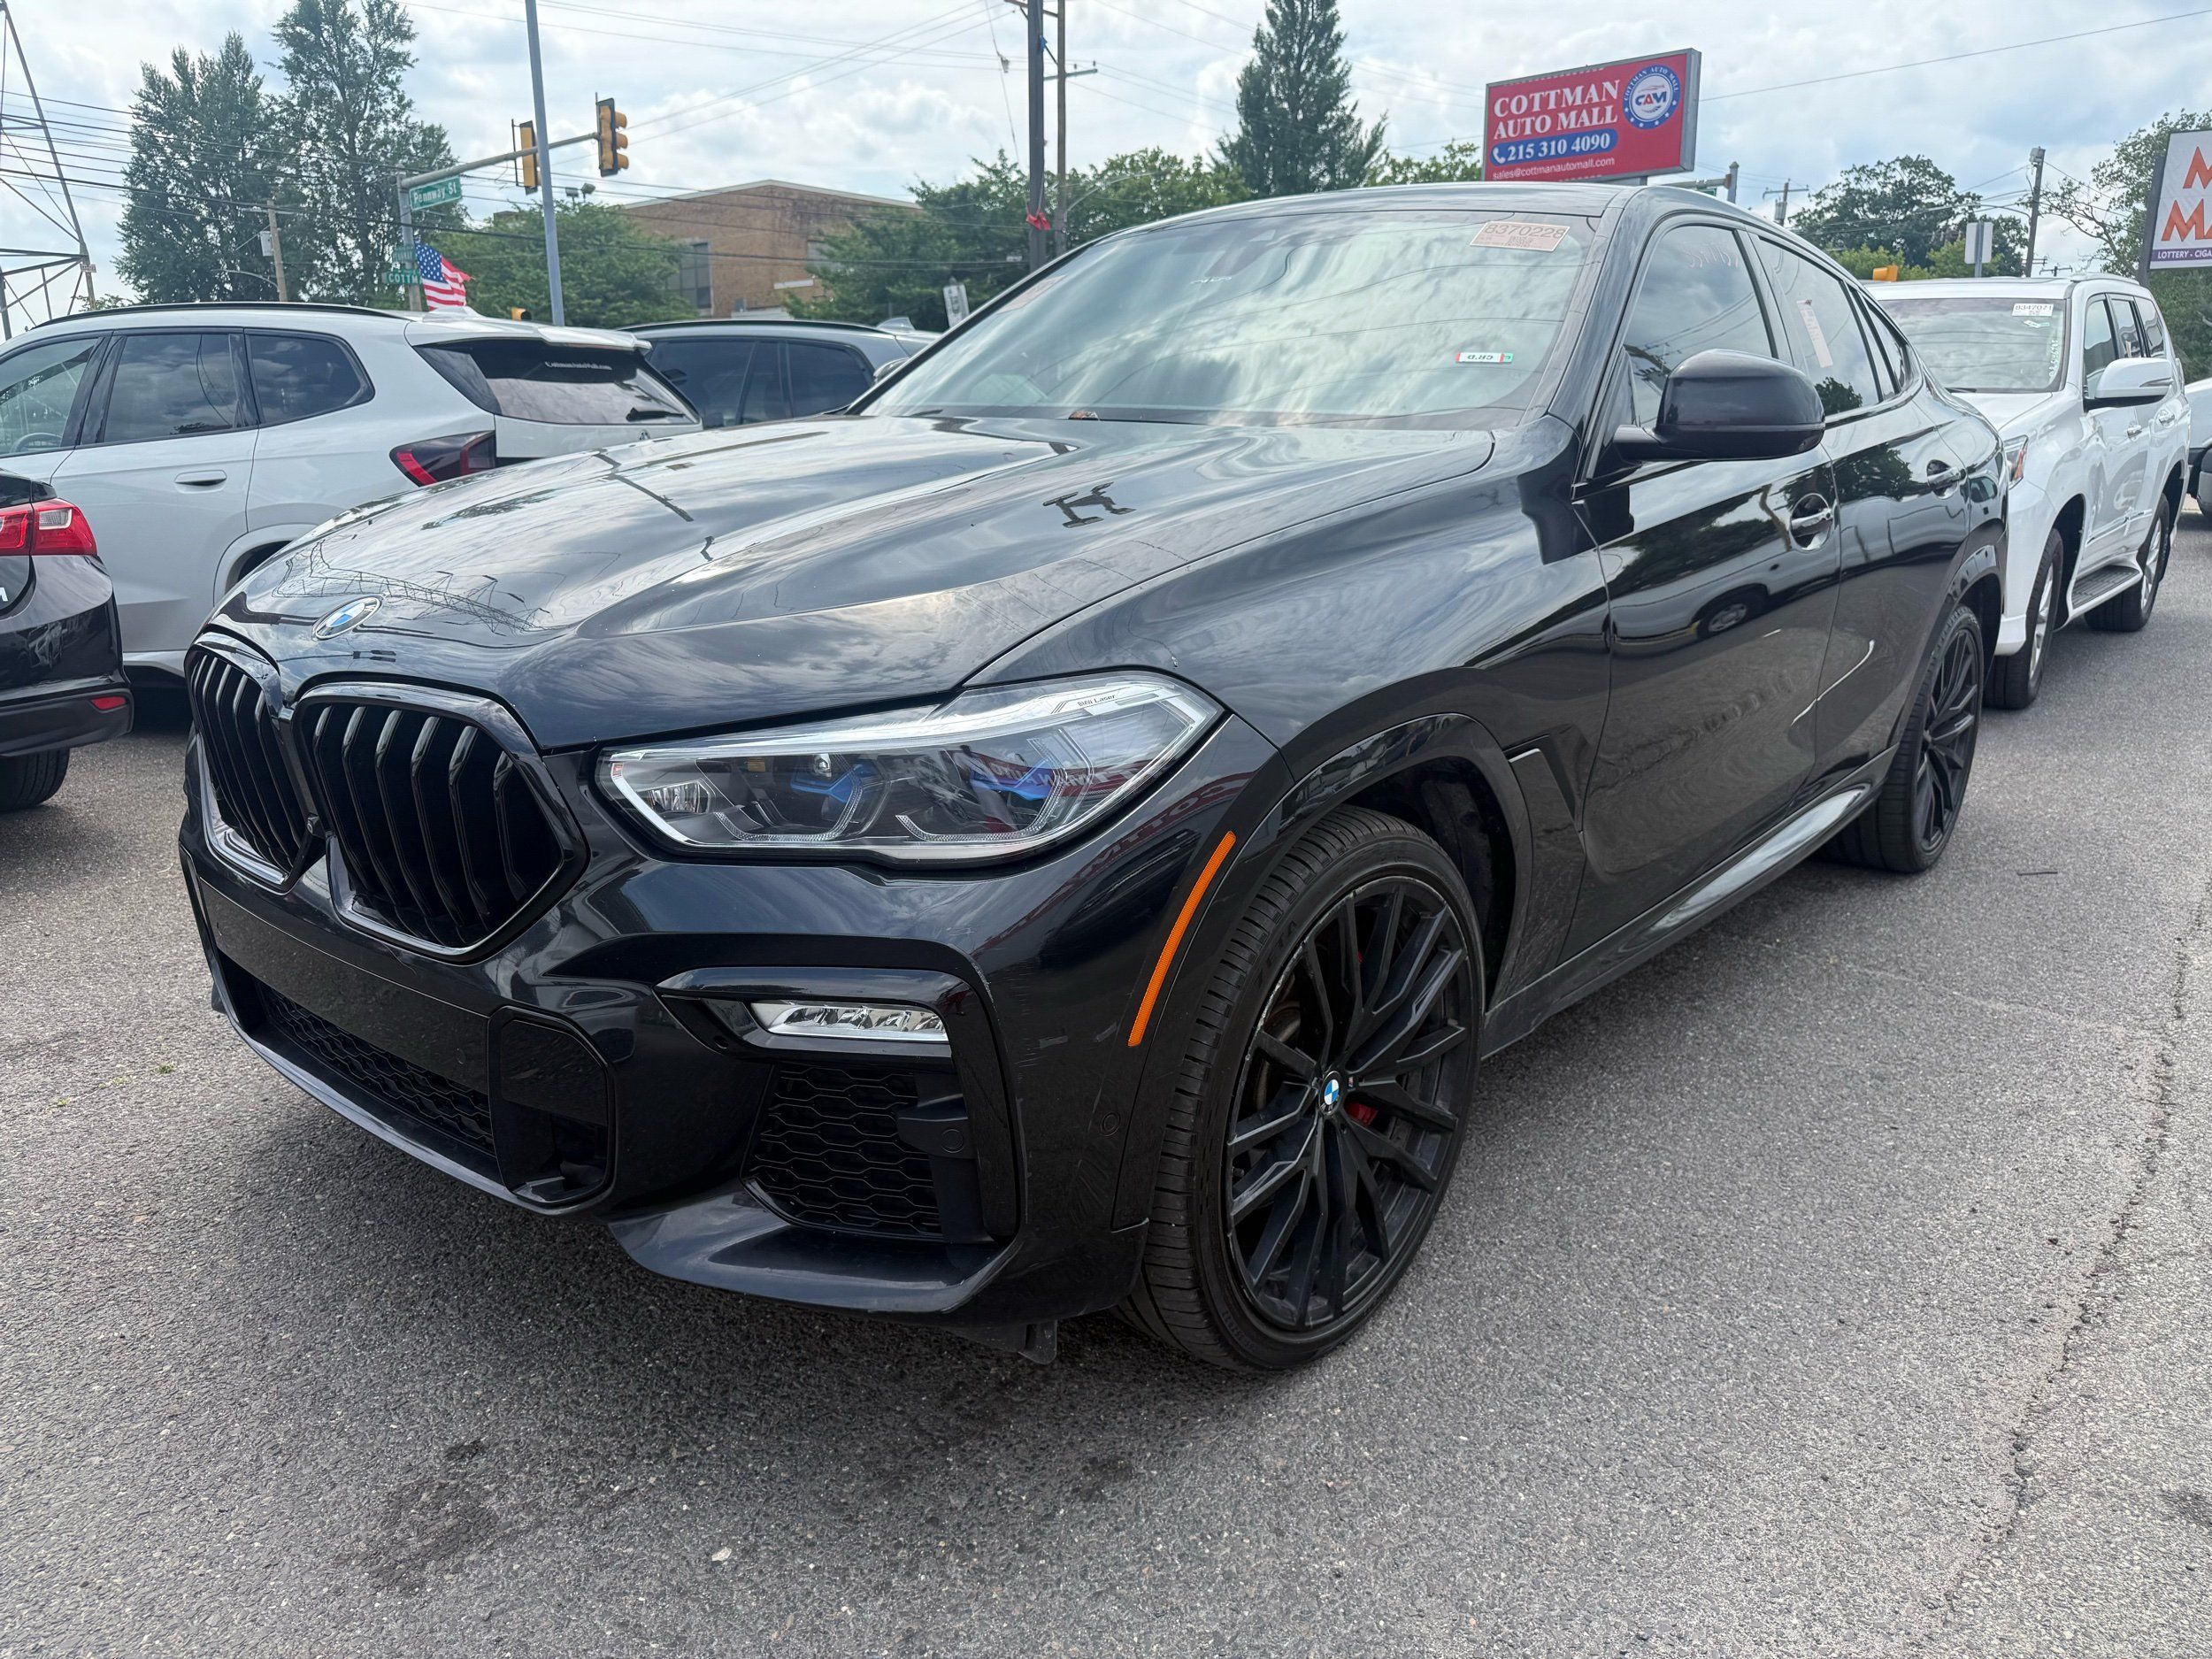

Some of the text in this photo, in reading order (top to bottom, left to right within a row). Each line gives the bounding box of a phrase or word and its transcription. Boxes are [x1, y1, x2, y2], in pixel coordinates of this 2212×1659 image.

[1494, 79, 1621, 118] COTTMAN
[1494, 104, 1617, 140] AUTO MALL
[1508, 133, 1610, 161] 215 310 4090
[1493, 157, 1615, 180] sales@cottmanautomall.com
[449, 181, 457, 195] St
[1485, 224, 1566, 239] 8370228
[2158, 250, 2189, 259] LOTTERY
[388, 273, 421, 283] COTTM
